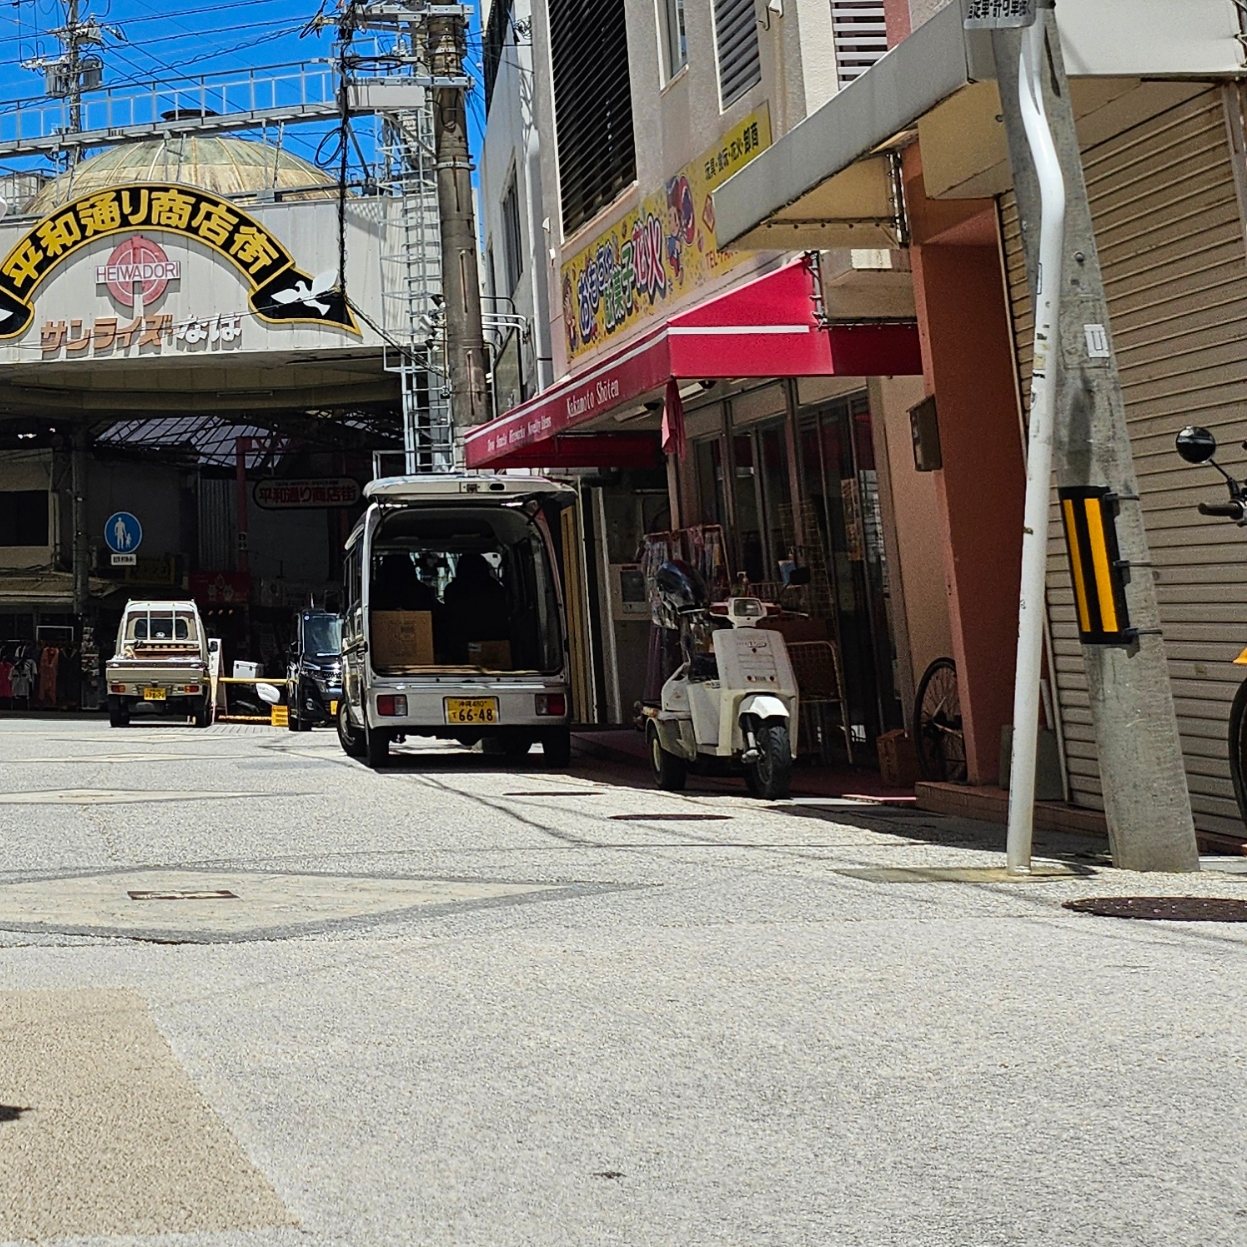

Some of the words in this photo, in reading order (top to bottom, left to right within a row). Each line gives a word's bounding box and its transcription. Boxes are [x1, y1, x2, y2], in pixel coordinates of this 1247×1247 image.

[4, 189, 280, 288] 平和通り商店街
[96, 264, 180, 282] HEIWADORI
[459, 709, 493, 721] 66-48
